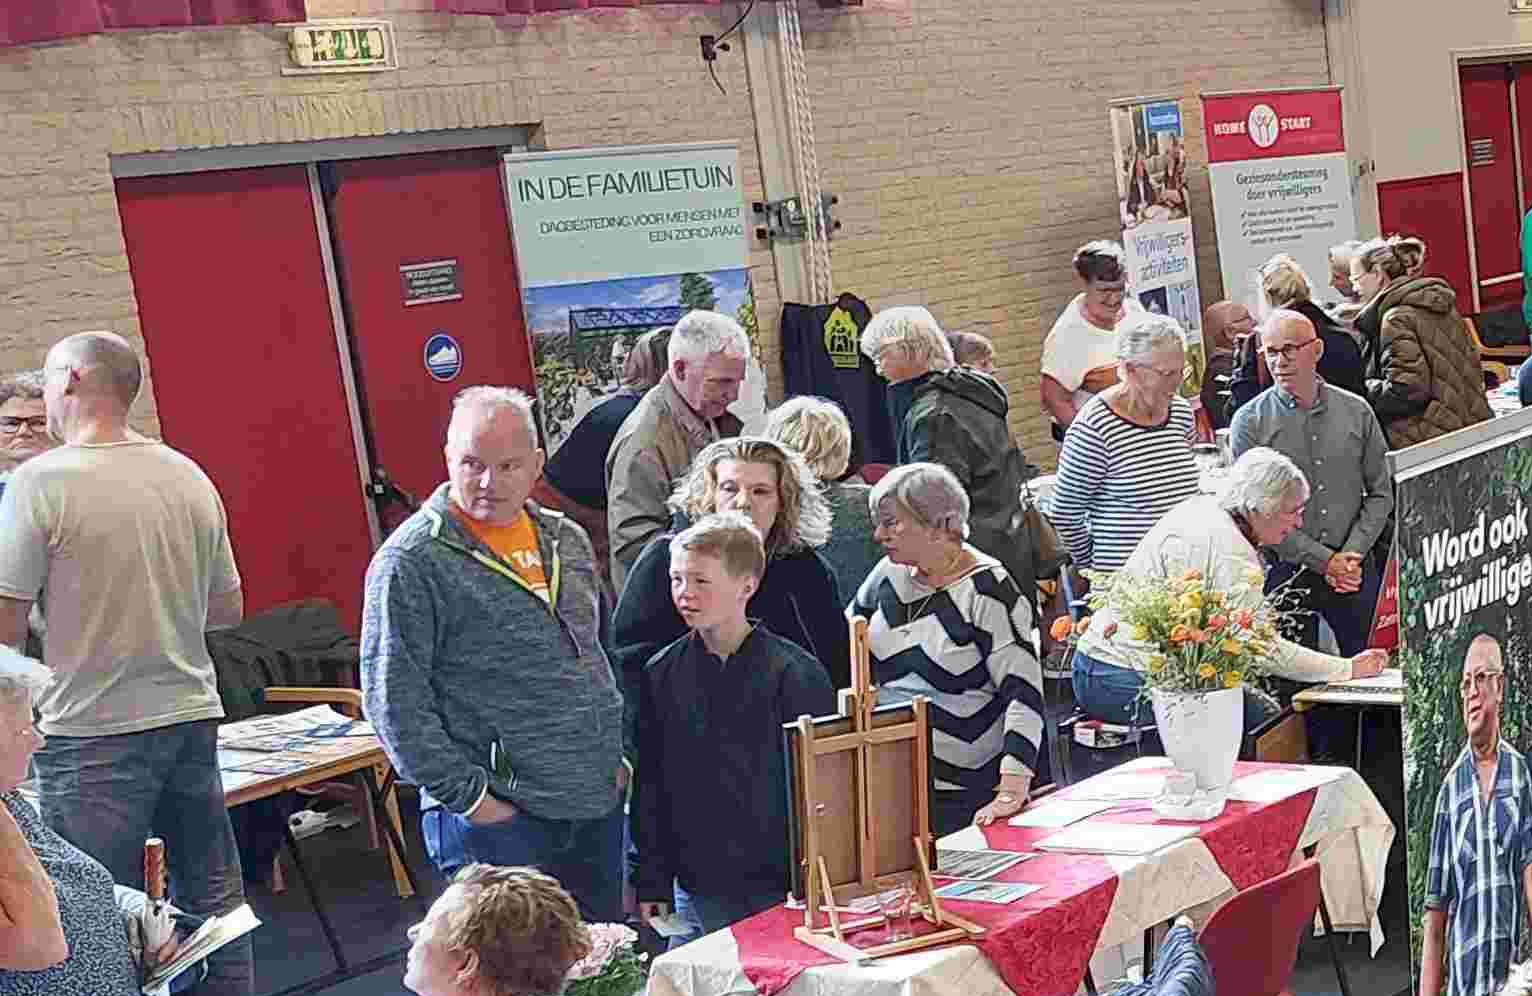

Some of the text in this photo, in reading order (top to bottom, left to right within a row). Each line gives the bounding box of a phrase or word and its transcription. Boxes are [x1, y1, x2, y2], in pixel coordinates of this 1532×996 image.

[1279, 117, 1312, 131] START
[518, 165, 733, 202] IN DE FAMILIETUIN
[1422, 499, 1529, 577] Word ook
